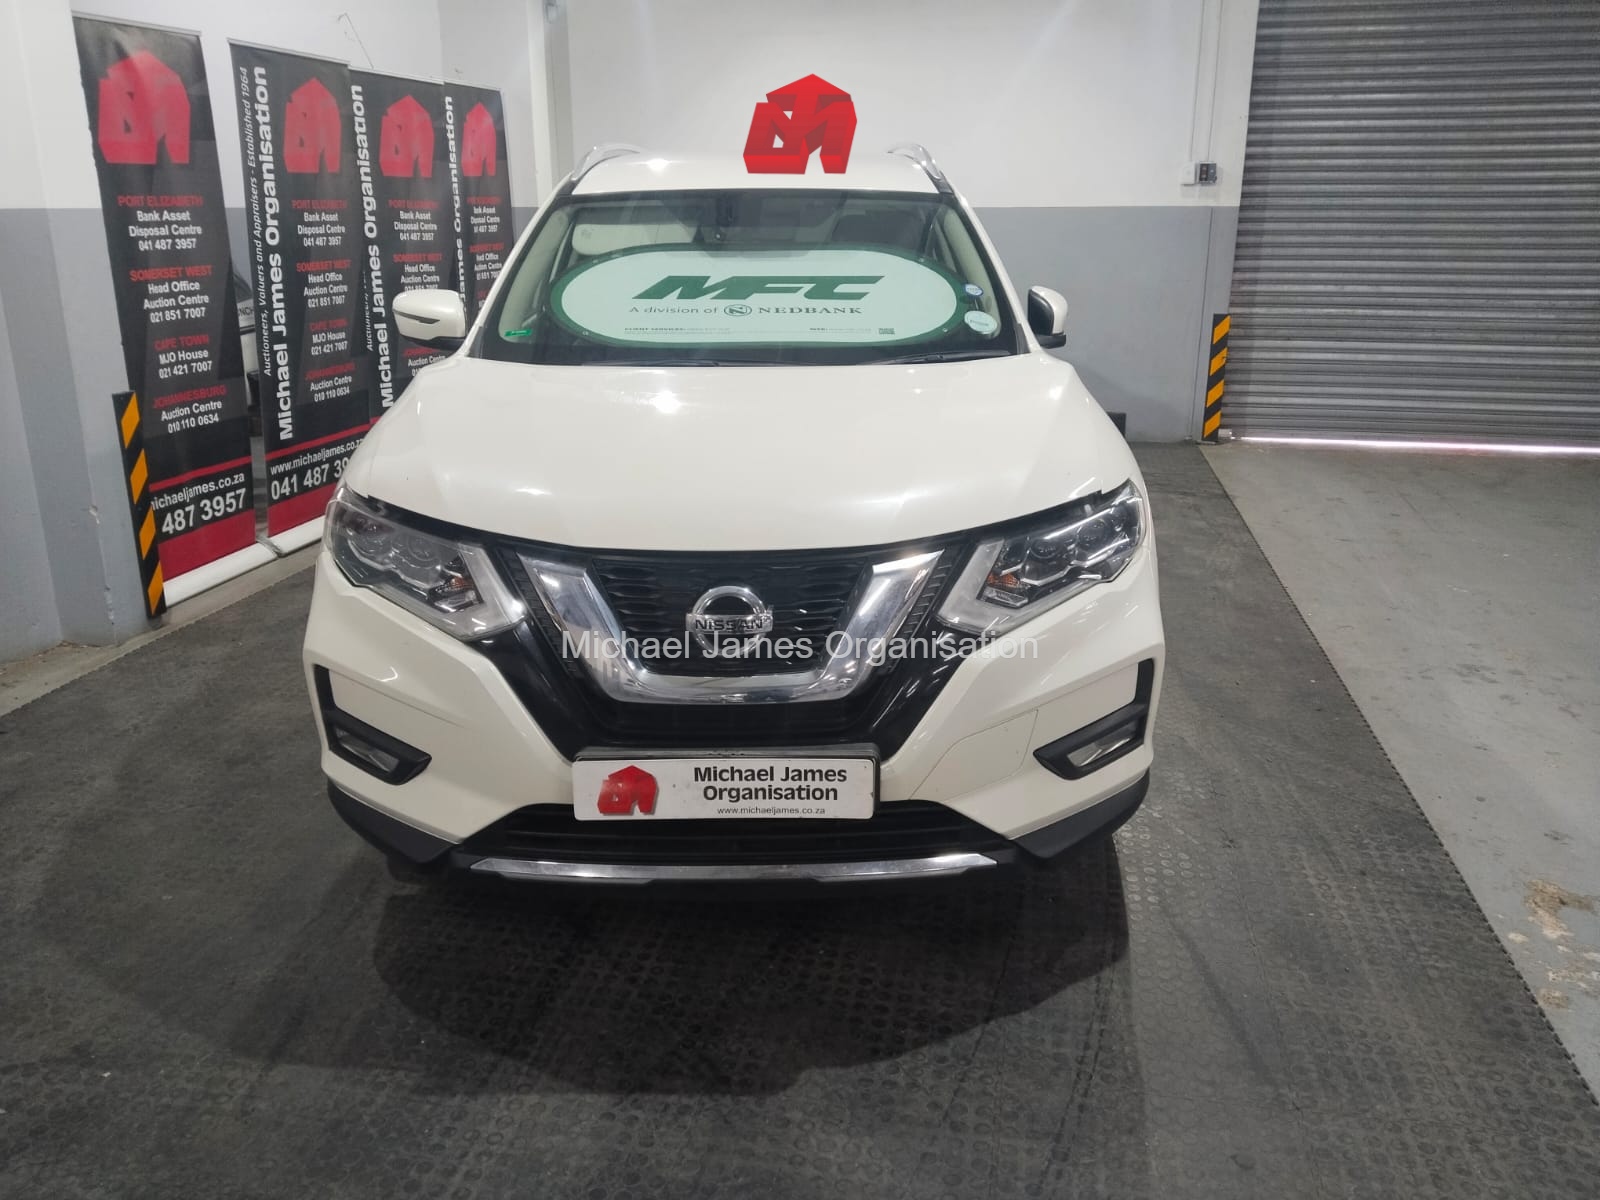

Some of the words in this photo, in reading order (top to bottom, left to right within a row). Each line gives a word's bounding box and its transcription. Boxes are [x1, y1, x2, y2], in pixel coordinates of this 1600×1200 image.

[240, 67, 249, 97] 1964
[242, 100, 256, 168] Established
[254, 66, 280, 247] Organisation
[351, 85, 377, 239] Organisation
[137, 210, 160, 221] Bank
[163, 210, 191, 221] Asset
[250, 178, 262, 238] Appraisers
[400, 210, 414, 220] Bank
[304, 212, 320, 222] Bank
[321, 212, 339, 222] Asset
[129, 226, 169, 238] Disposal
[172, 224, 202, 235] Centre
[298, 224, 325, 236] Disposal
[326, 224, 346, 234] Centre
[394, 222, 419, 231] Disposal
[139, 240, 153, 252] 041
[155, 240, 172, 250] 487
[176, 238, 197, 250] 3957
[255, 240, 264, 261] and
[420, 264, 435, 272] Office
[257, 264, 265, 306] Valuers
[308, 273, 324, 284] Head
[325, 272, 343, 282] Office
[369, 244, 385, 317] James
[401, 274, 422, 284] Auction
[148, 282, 169, 294] Head
[171, 281, 200, 292] Office
[269, 253, 287, 337] James
[304, 286, 327, 297] Auction
[329, 284, 348, 293] Centre
[632, 276, 885, 300] MFC
[144, 298, 176, 310] Auction
[178, 294, 209, 306] Centre
[630, 306, 640, 314] A
[644, 305, 699, 314] division
[704, 305, 718, 314] of
[150, 312, 163, 323] 021
[166, 310, 181, 321] 851
[184, 307, 206, 319] 7007
[262, 310, 272, 377] Auctioneers,
[327, 331, 346, 341] House
[178, 350, 209, 361] House
[159, 368, 172, 379] 021
[173, 364, 188, 376] 421
[191, 360, 213, 373] 7007
[374, 324, 394, 408] Michael
[310, 379, 334, 391] Auction
[334, 376, 353, 386] Centre
[274, 344, 293, 441] Michael
[162, 408, 191, 421] Auction
[192, 400, 222, 414] Centre
[168, 422, 180, 434] 010
[182, 418, 196, 428] 110
[198, 413, 219, 426] 0634
[271, 475, 298, 500] 041
[303, 464, 329, 488] 487
[162, 504, 195, 535] 487
[201, 488, 247, 521] 3957
[696, 620, 763, 631] NISSAN
[694, 766, 774, 783] Michael
[780, 766, 847, 783] James
[703, 784, 838, 803] Organisation
[717, 806, 826, 816] www.michaeljames.co.za
